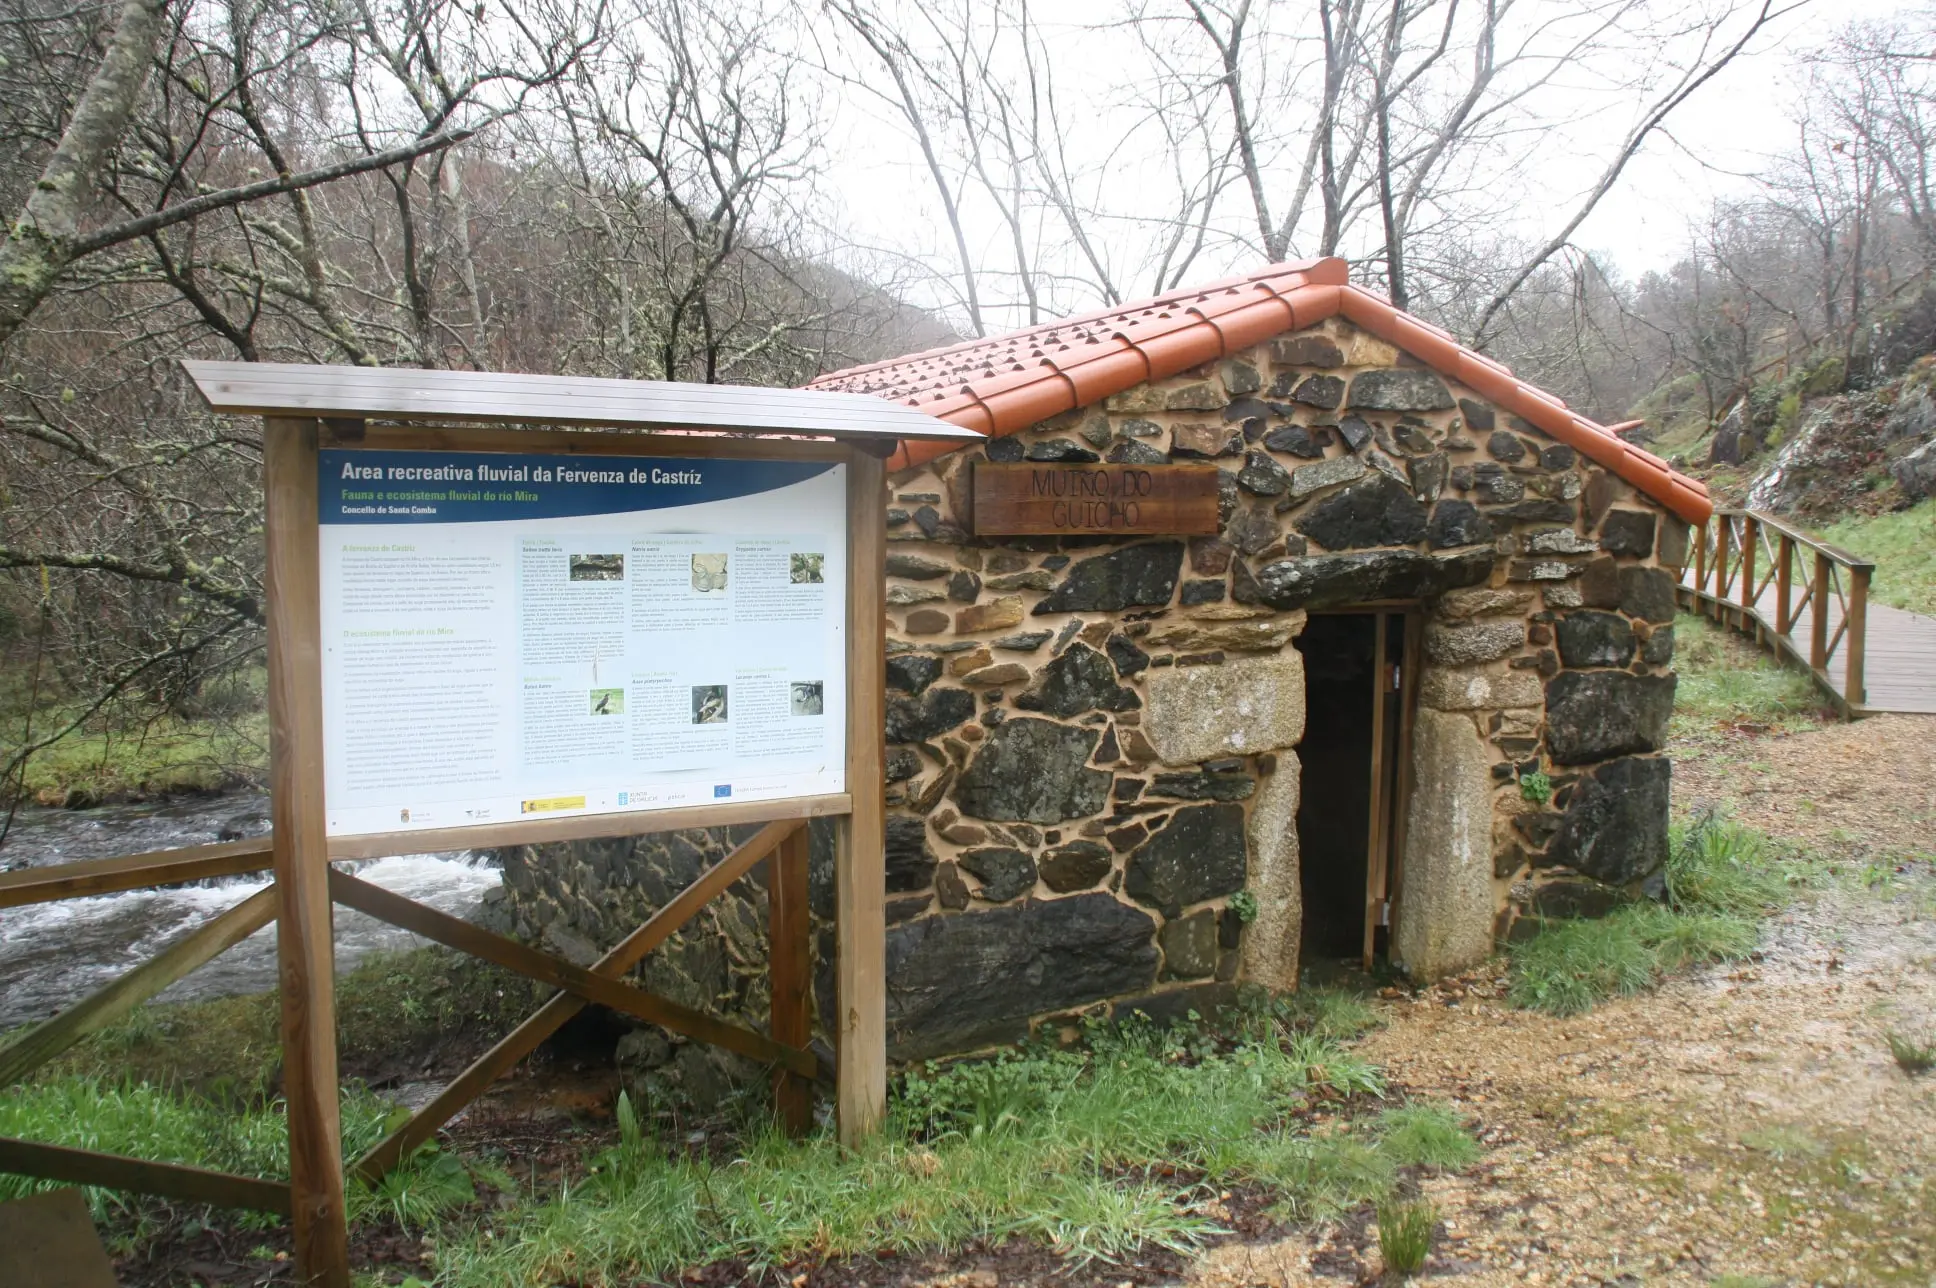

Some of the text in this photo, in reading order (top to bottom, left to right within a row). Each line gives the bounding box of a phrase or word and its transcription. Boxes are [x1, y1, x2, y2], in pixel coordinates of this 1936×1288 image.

[341, 462, 702, 485] Area recreativa fluvial da Fervenza de Castríz
[1123, 470, 1152, 497] DO
[341, 489, 374, 500] Fauna
[377, 492, 384, 500] e
[386, 489, 446, 501] ecosistema
[449, 489, 481, 501] fluvial
[484, 490, 496, 501] do
[515, 490, 539, 502] Mira
[341, 505, 437, 514] Concello de Santa Comba
[1051, 501, 1140, 528] GUICHO
